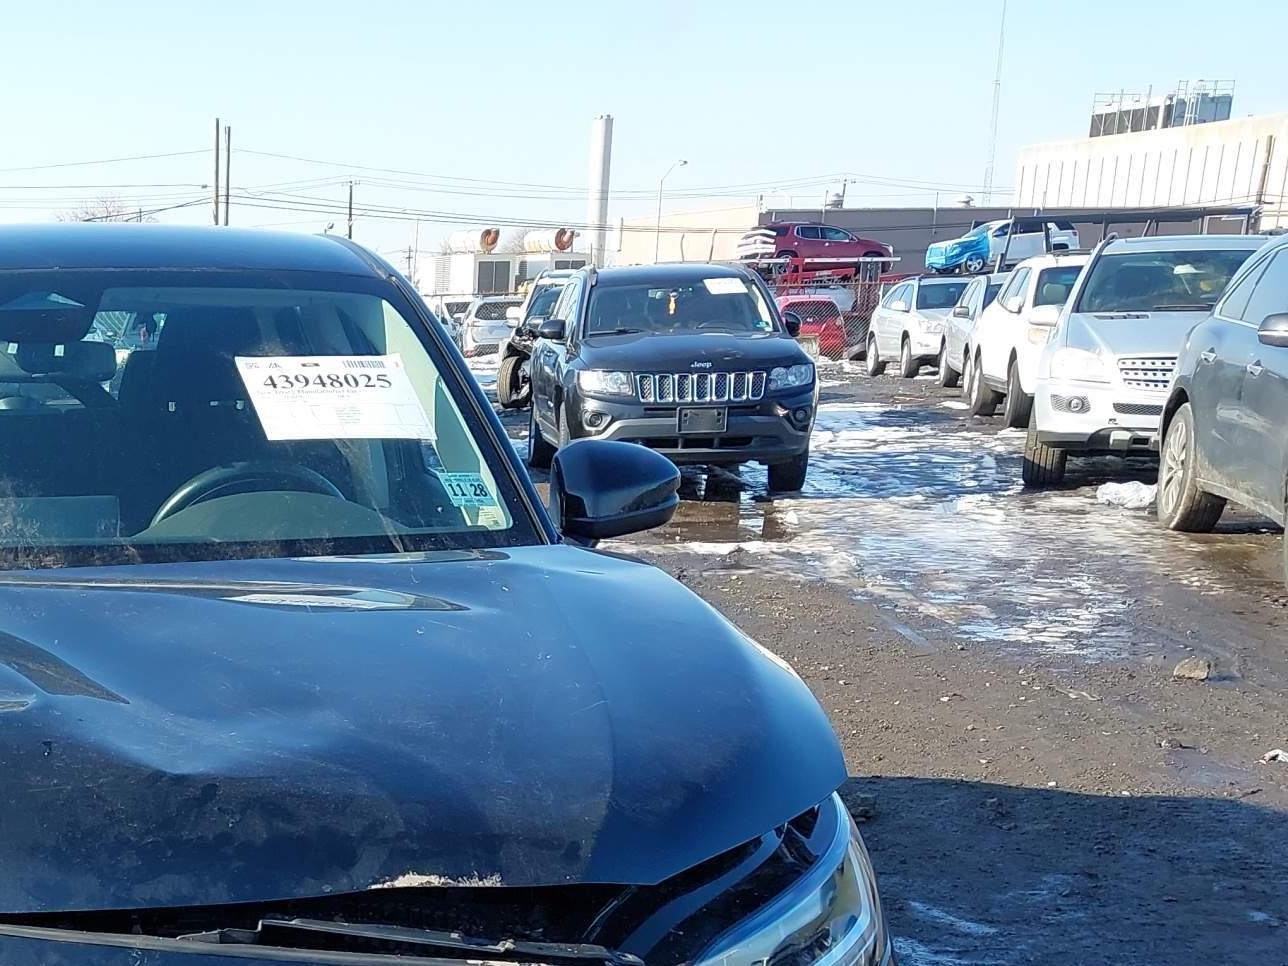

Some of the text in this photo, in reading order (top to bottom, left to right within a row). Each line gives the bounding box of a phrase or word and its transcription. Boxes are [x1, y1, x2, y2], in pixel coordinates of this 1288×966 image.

[263, 373, 392, 389] 43948025
[447, 483, 488, 497] 11 28
